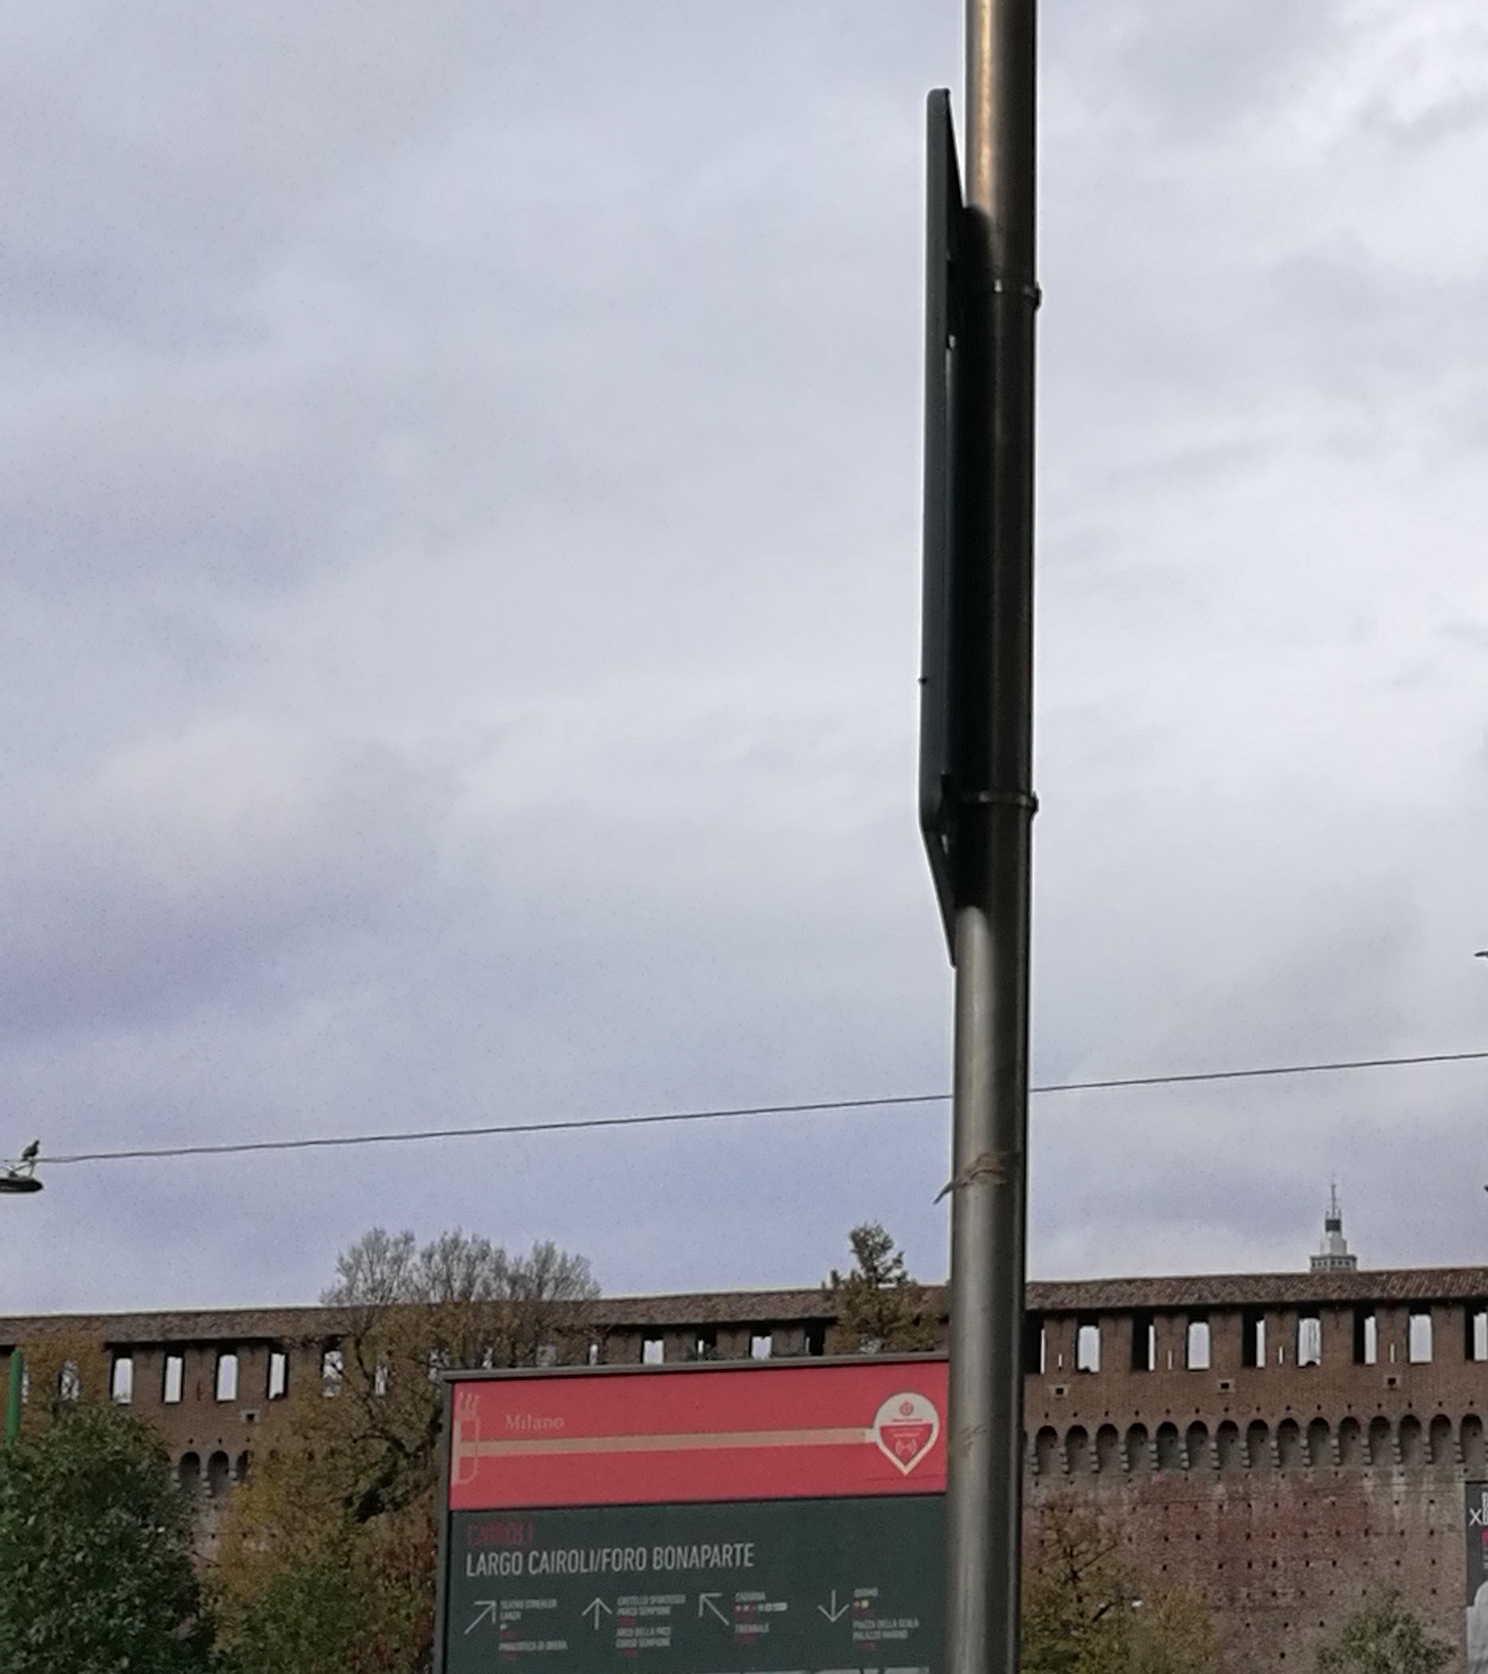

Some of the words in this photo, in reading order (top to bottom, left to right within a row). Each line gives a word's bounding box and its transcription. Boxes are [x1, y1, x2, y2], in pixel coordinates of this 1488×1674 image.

[505, 1413, 564, 1430] Milano
[1468, 1508, 1482, 1526] X
[467, 1521, 533, 1547] CAIROLI
[466, 1551, 523, 1577] LARGO
[528, 1547, 647, 1575] CAIROLI/FORO
[652, 1543, 755, 1571] BONAPARTE
